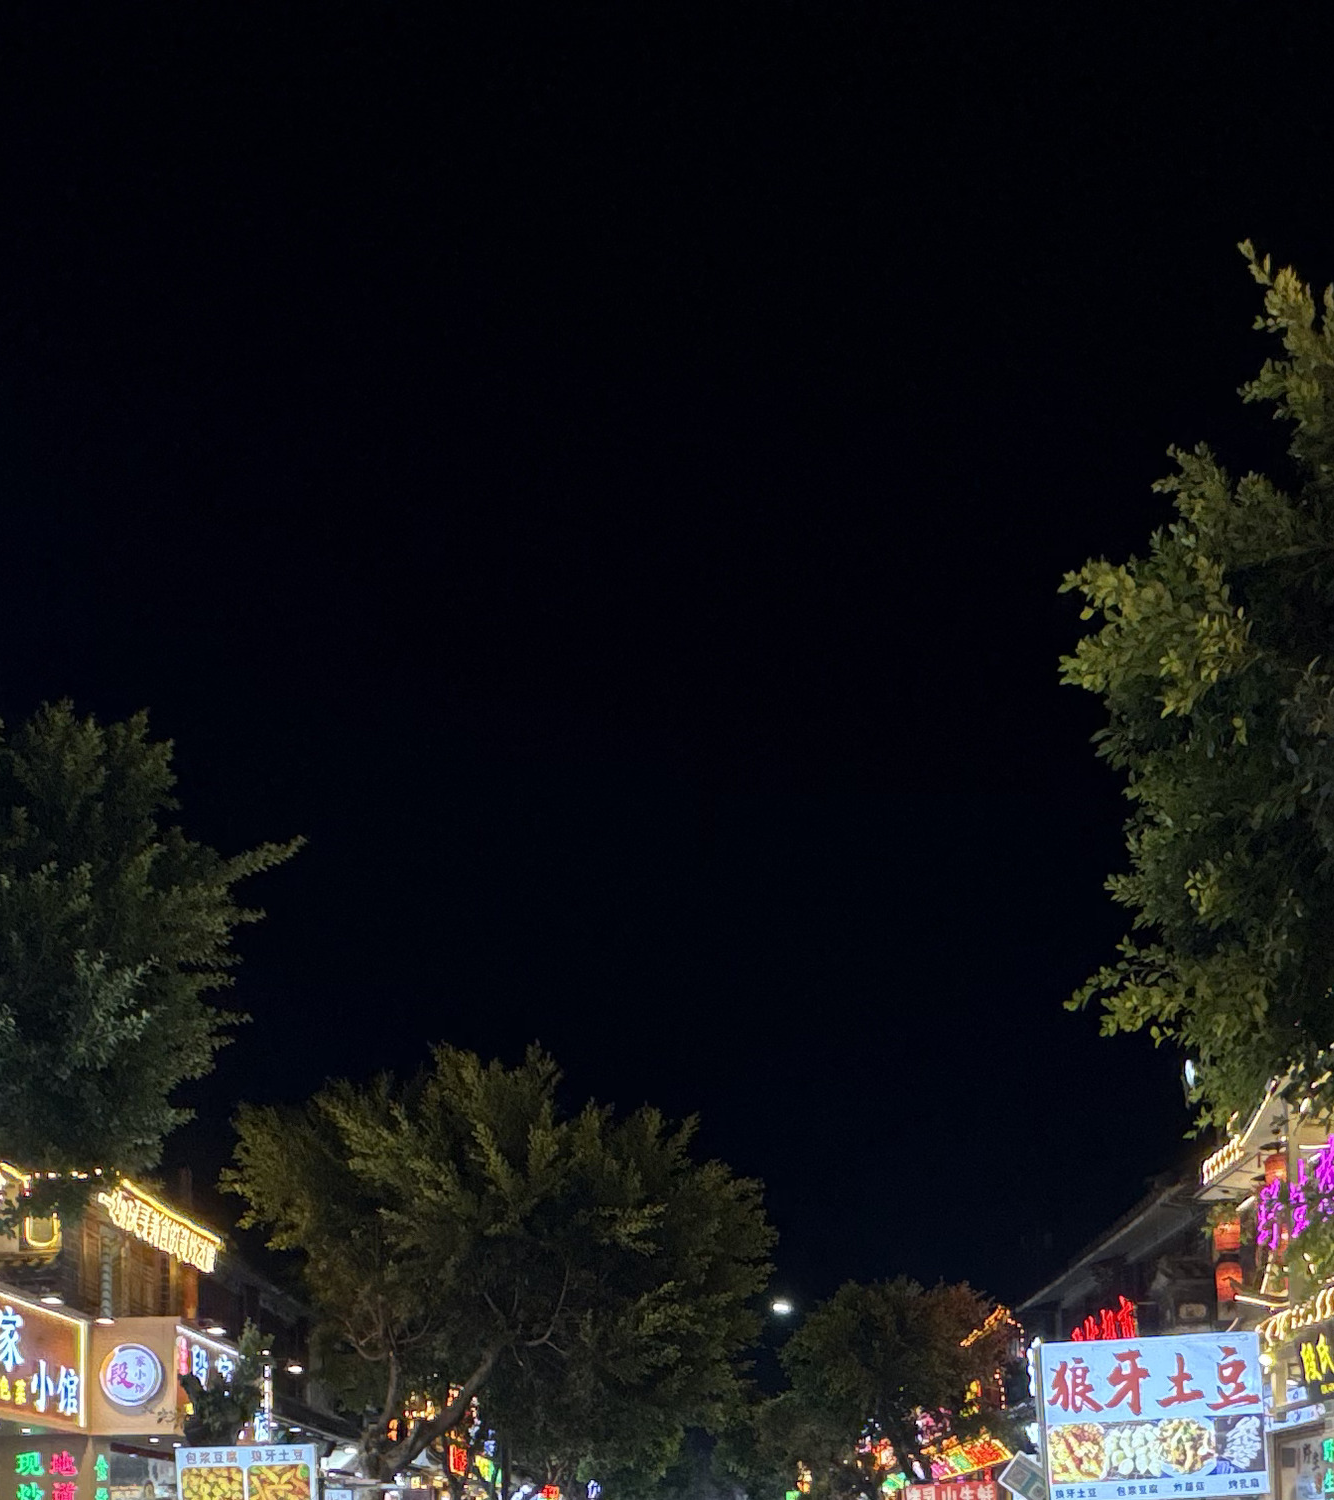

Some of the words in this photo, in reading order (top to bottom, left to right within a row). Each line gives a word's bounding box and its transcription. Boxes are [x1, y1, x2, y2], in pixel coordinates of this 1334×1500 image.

[30, 1359, 82, 1417] 小馆
[1048, 1345, 1261, 1416] 狼牙土豆
